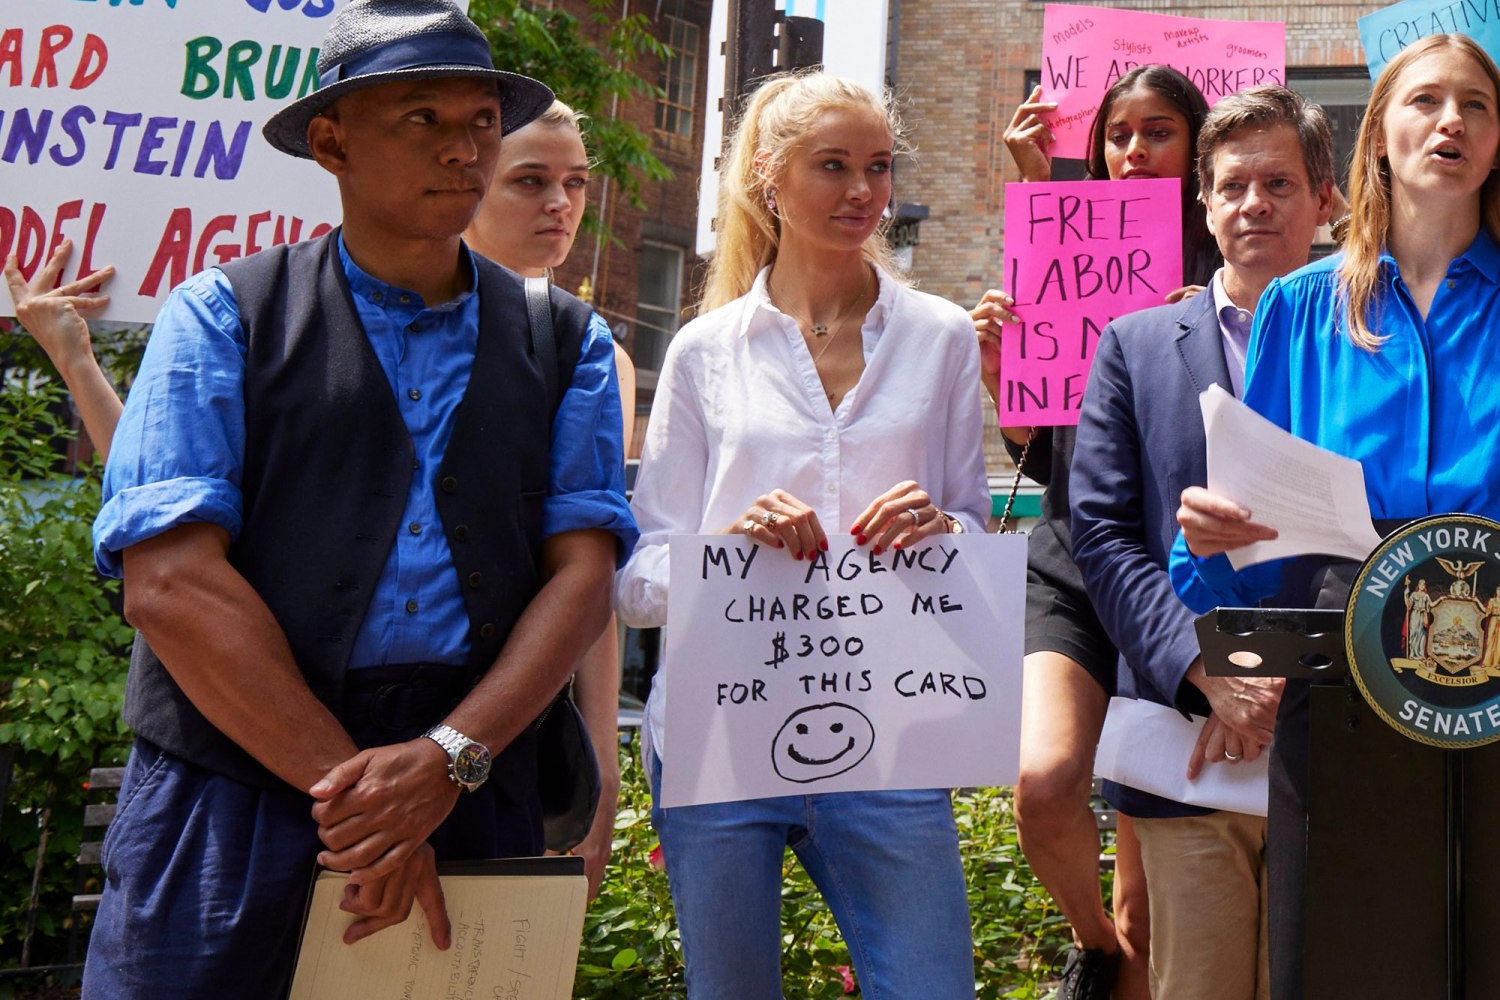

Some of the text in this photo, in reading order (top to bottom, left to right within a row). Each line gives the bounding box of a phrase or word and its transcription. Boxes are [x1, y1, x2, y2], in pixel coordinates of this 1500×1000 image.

[1052, 17, 1094, 45] models
[1046, 55, 1089, 90] WE
[0, 104, 253, 181] NSTEIN
[1028, 192, 1152, 246] FREE
[1010, 249, 1159, 308] LABOR
[1019, 321, 1059, 361] IS
[1007, 376, 1049, 413] IN
[702, 543, 960, 584] MY AGENCY
[1365, 541, 1415, 599] NEW
[1417, 526, 1492, 553] YORK
[724, 591, 963, 624] CHARGED ME
[764, 631, 865, 670] $300
[716, 669, 988, 706] FOR THIS CARD
[1426, 672, 1480, 685] EXCELSIOR
[511, 918, 531, 961] FIGHT
